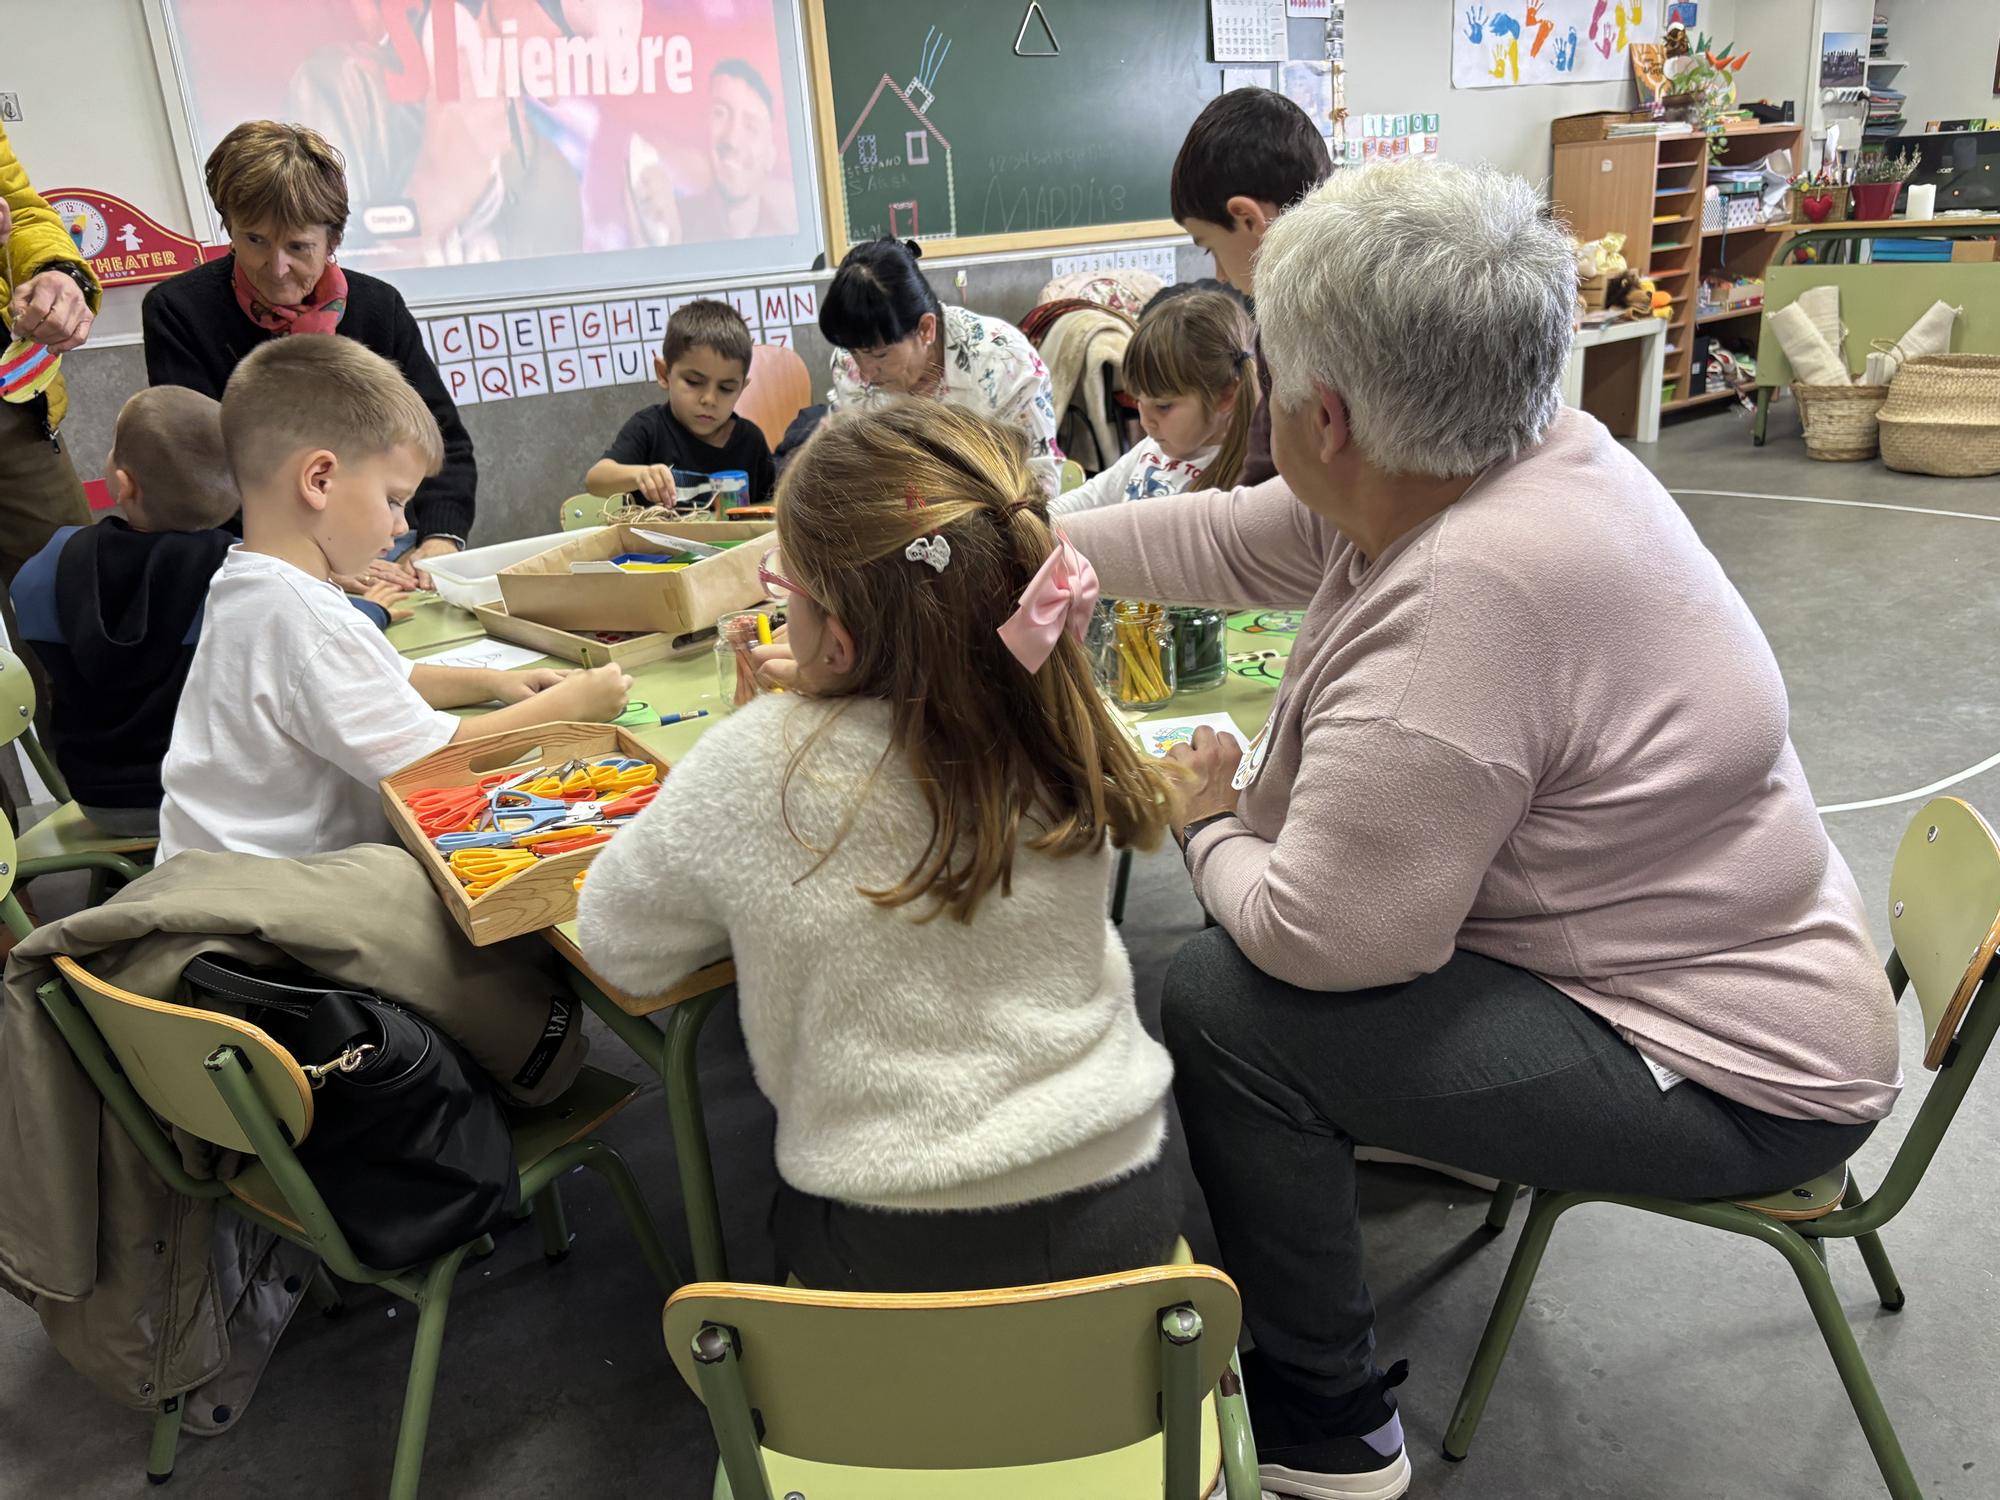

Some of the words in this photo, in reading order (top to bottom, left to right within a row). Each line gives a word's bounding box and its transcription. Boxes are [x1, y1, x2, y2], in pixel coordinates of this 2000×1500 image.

[443, 326, 462, 353] C
[478, 323, 499, 350] D
[515, 319, 533, 346] E
[549, 315, 566, 344] F
[582, 312, 601, 338] G
[613, 308, 634, 336] H
[647, 307, 663, 332] I
[765, 295, 786, 321] M
[794, 292, 814, 318] N
[450, 371, 466, 398] P
[481, 367, 511, 396] Q
[520, 363, 541, 388] R
[558, 359, 576, 384] S
[587, 354, 607, 378] T
[619, 350, 638, 375] U
